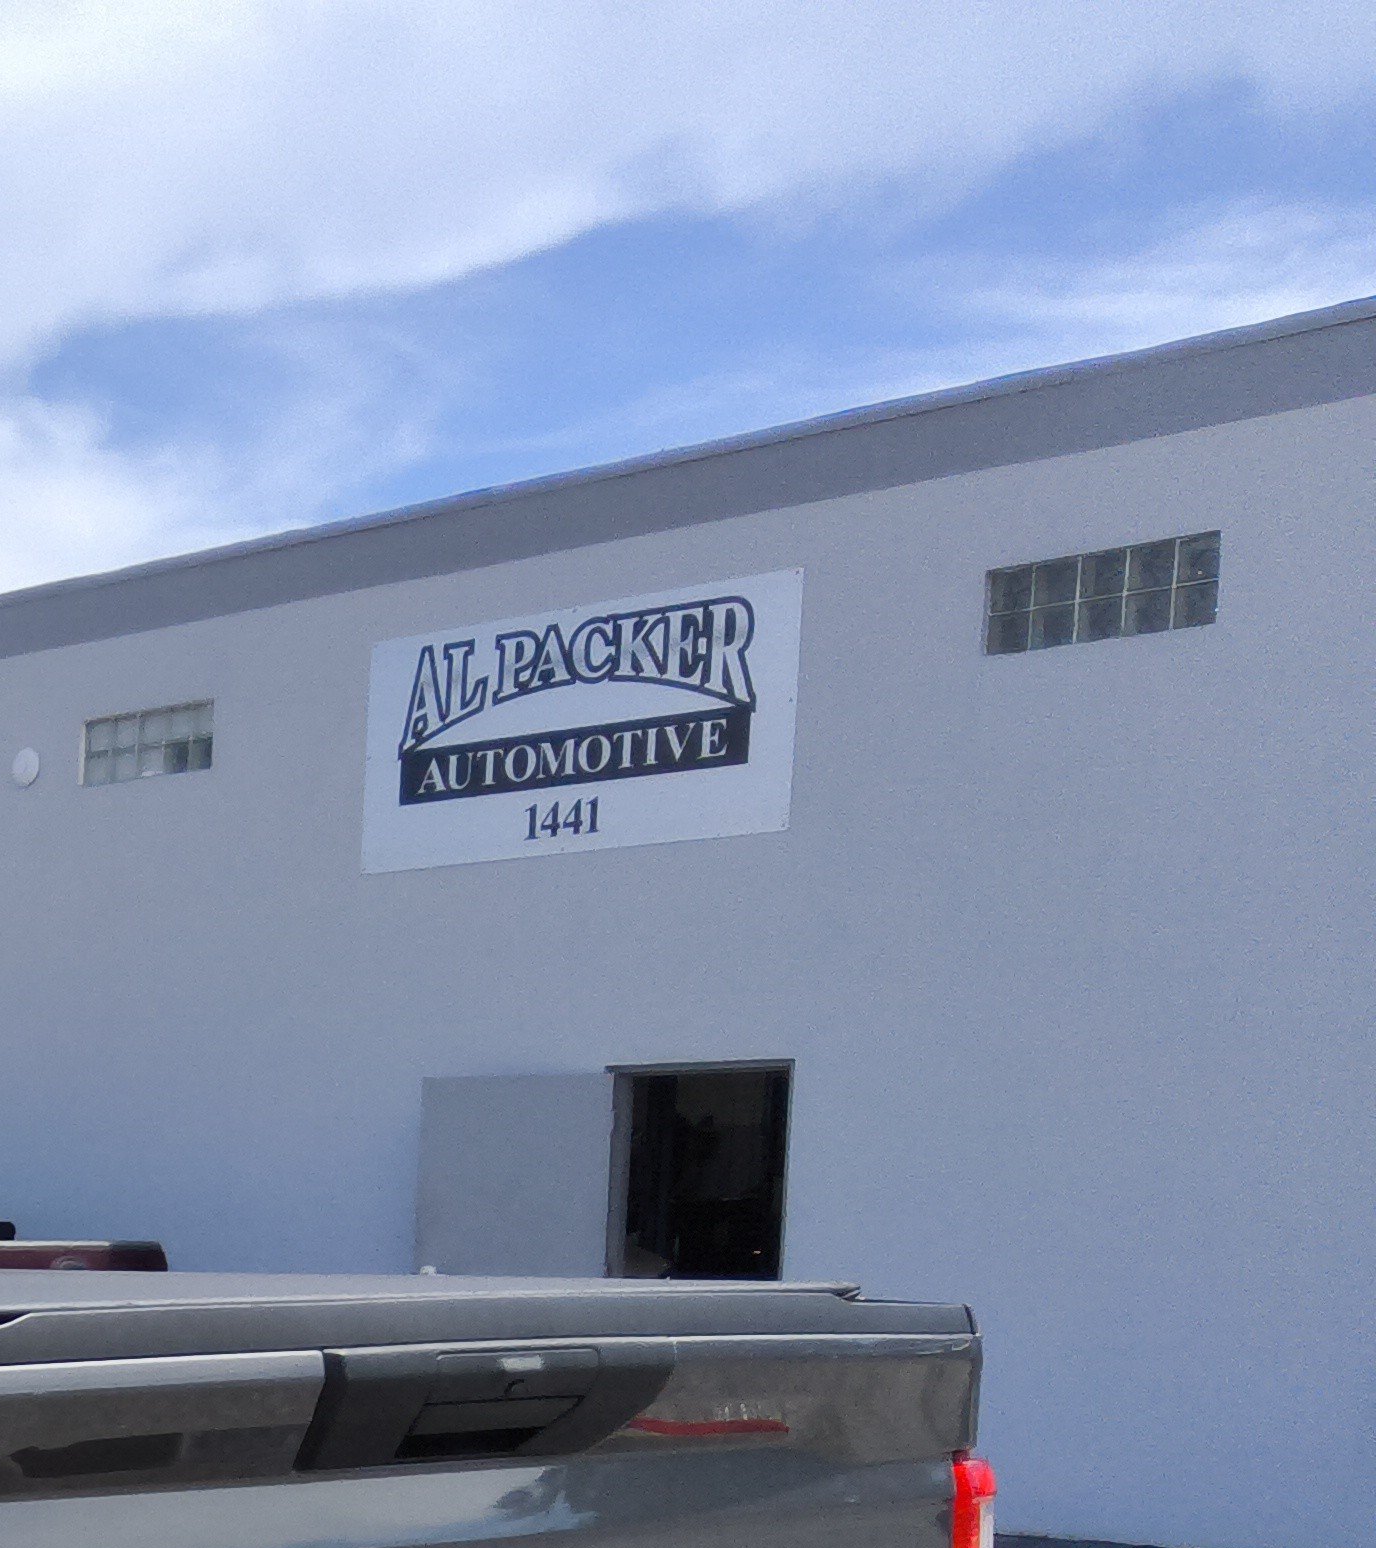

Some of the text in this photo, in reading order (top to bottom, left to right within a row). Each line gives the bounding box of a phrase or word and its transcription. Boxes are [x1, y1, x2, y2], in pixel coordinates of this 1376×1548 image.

[399, 596, 756, 758] AL PACKER
[416, 718, 729, 793] AUTOMOTIVE
[524, 796, 599, 841] 1441
